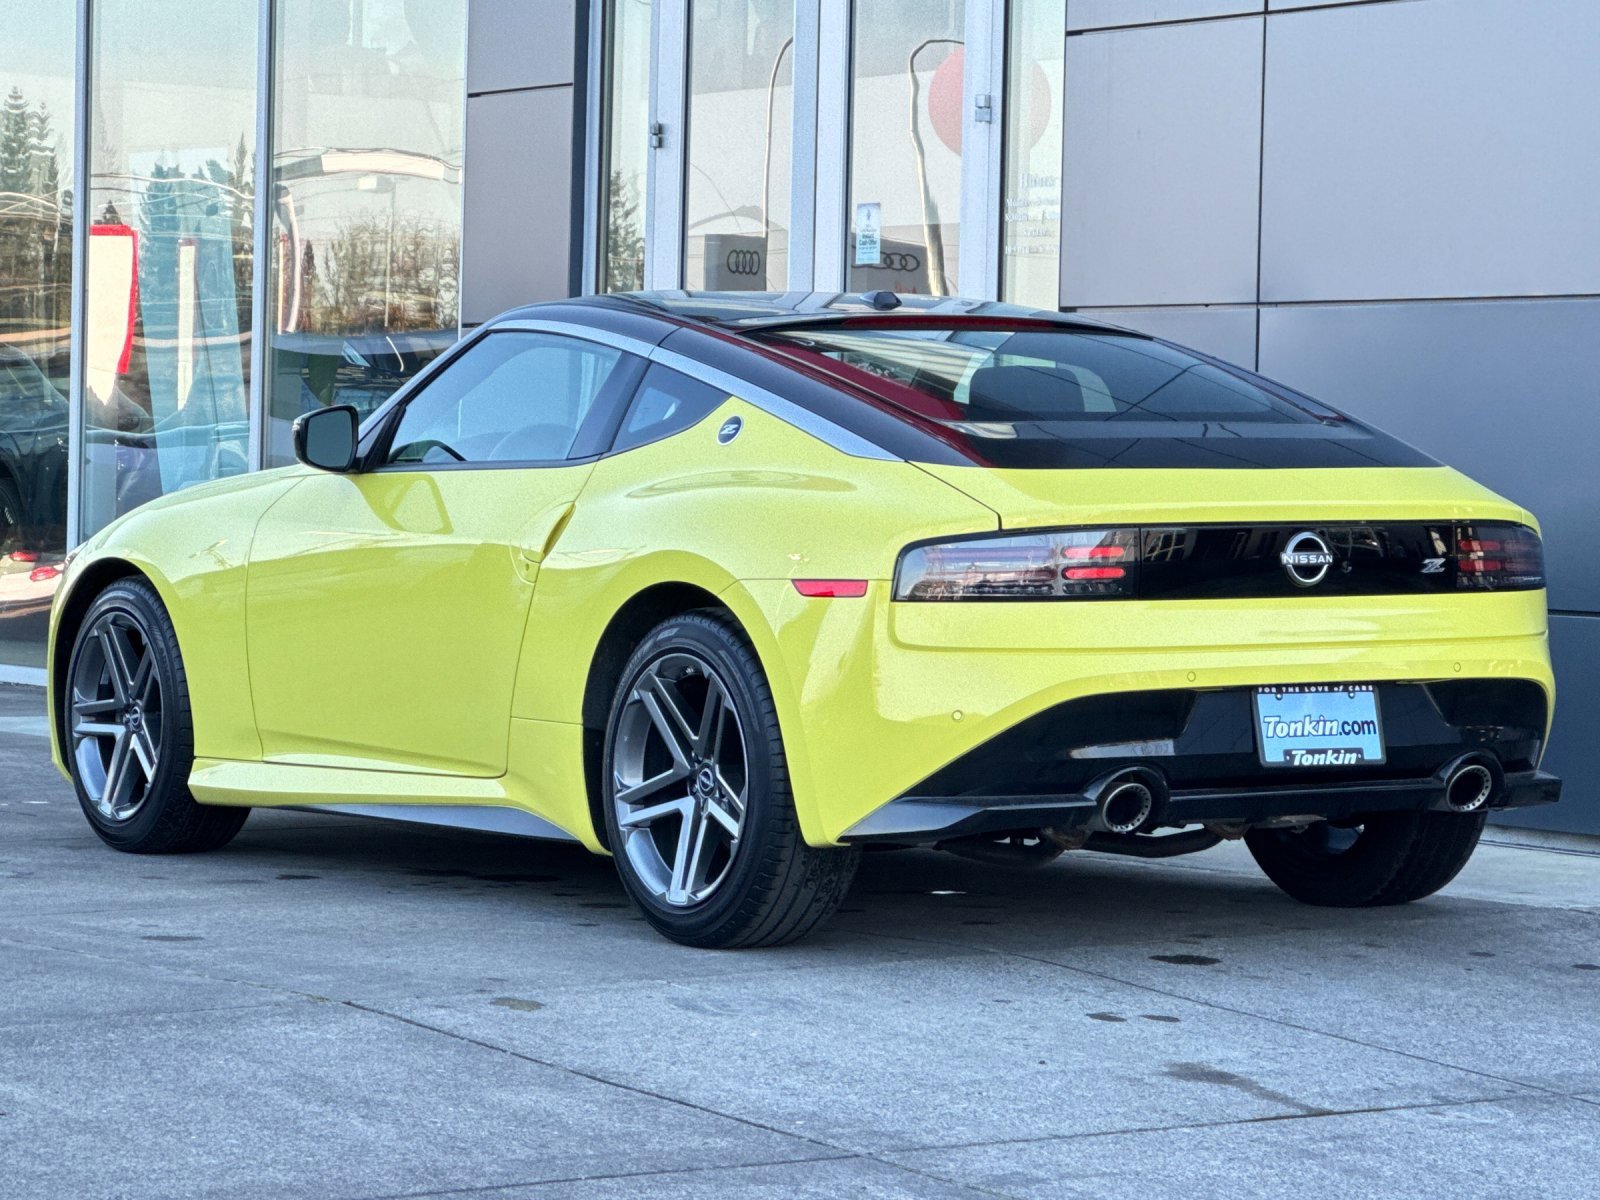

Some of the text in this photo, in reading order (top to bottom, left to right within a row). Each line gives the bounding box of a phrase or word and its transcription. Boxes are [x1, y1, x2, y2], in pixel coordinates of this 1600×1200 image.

[719, 423, 739, 435] Z
[1282, 554, 1333, 564] NISSAN
[1420, 557, 1447, 573] Z
[1263, 714, 1377, 738] Tonkin.com
[1291, 749, 1357, 766] Tonkin
